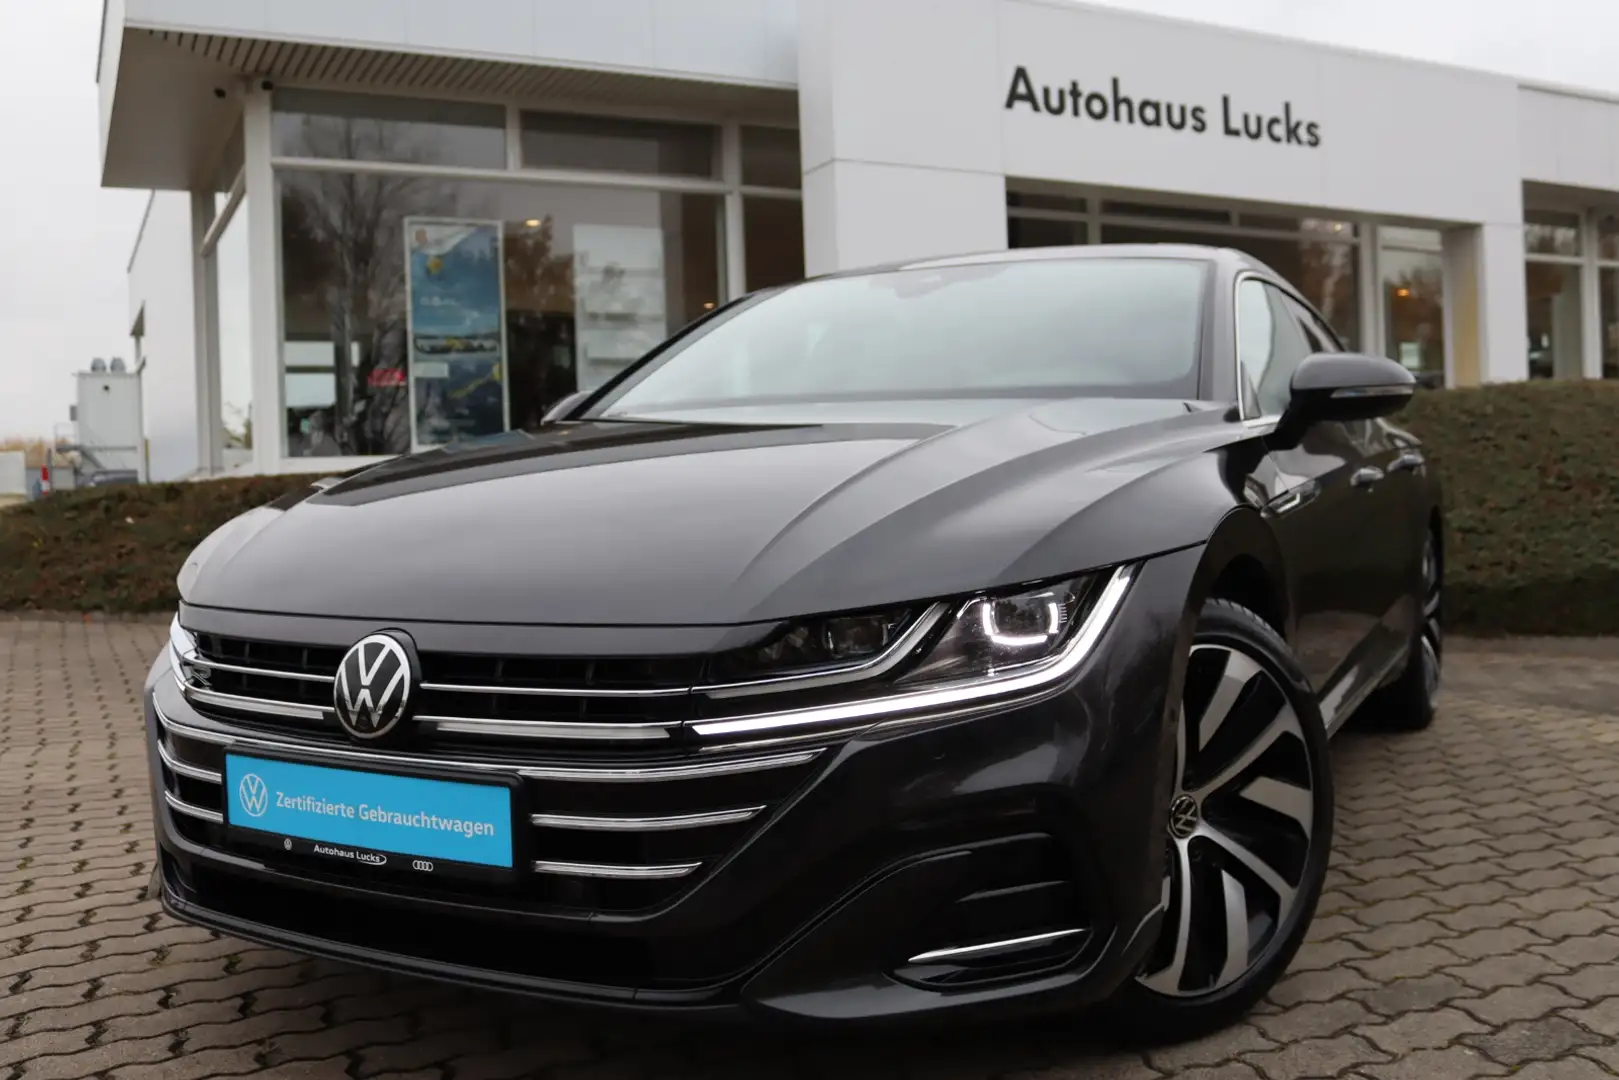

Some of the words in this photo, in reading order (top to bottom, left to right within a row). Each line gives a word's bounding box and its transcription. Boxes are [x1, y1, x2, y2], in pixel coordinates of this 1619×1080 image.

[1004, 65, 1207, 133] Autohaus
[1221, 94, 1321, 147] Lucks
[276, 791, 355, 818] Zertifizierte
[358, 804, 495, 838] Gebrauchtwagen
[313, 844, 354, 859] Autohaus
[356, 851, 381, 863] Lucks
